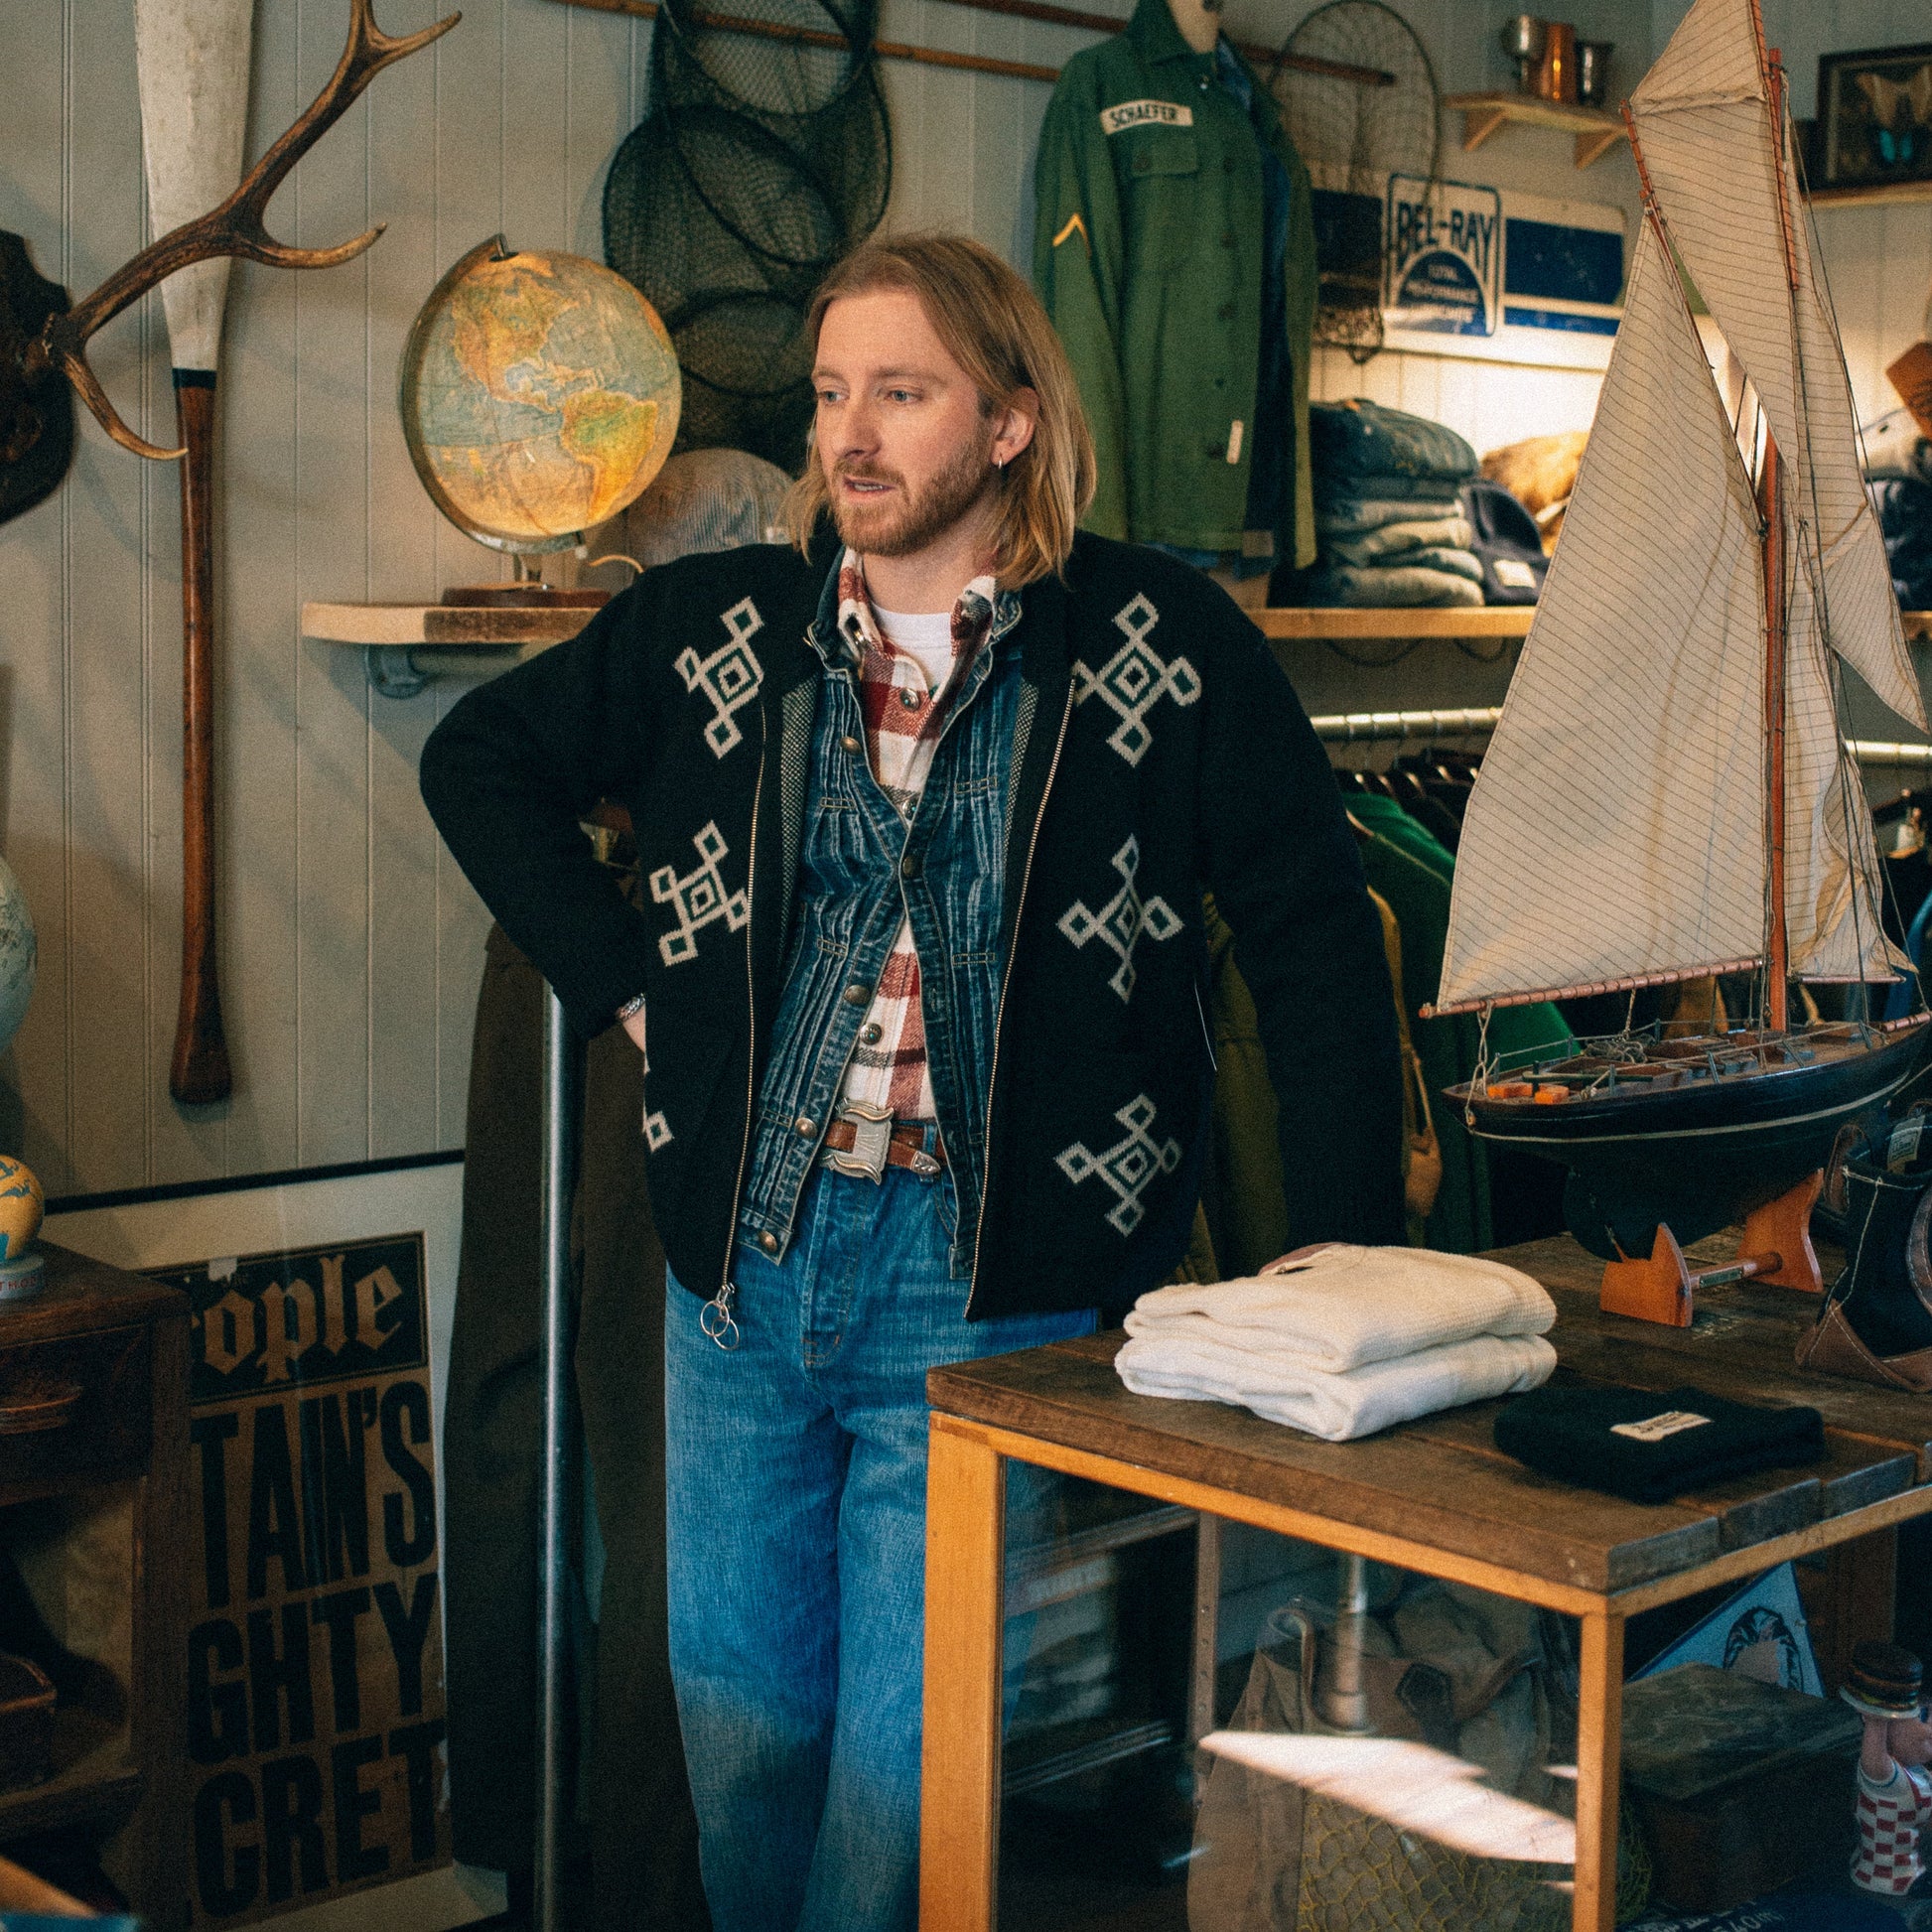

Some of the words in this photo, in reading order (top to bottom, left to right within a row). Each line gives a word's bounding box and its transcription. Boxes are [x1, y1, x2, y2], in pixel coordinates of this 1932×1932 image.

[1109, 103, 1177, 128] SCHAEFER
[1397, 201, 1494, 282] BEL-RAY
[191, 1253, 403, 1384] ople
[193, 1382, 437, 1610] TAIN'S
[188, 1573, 439, 1764] GHTY
[195, 1721, 445, 1919] CRET
